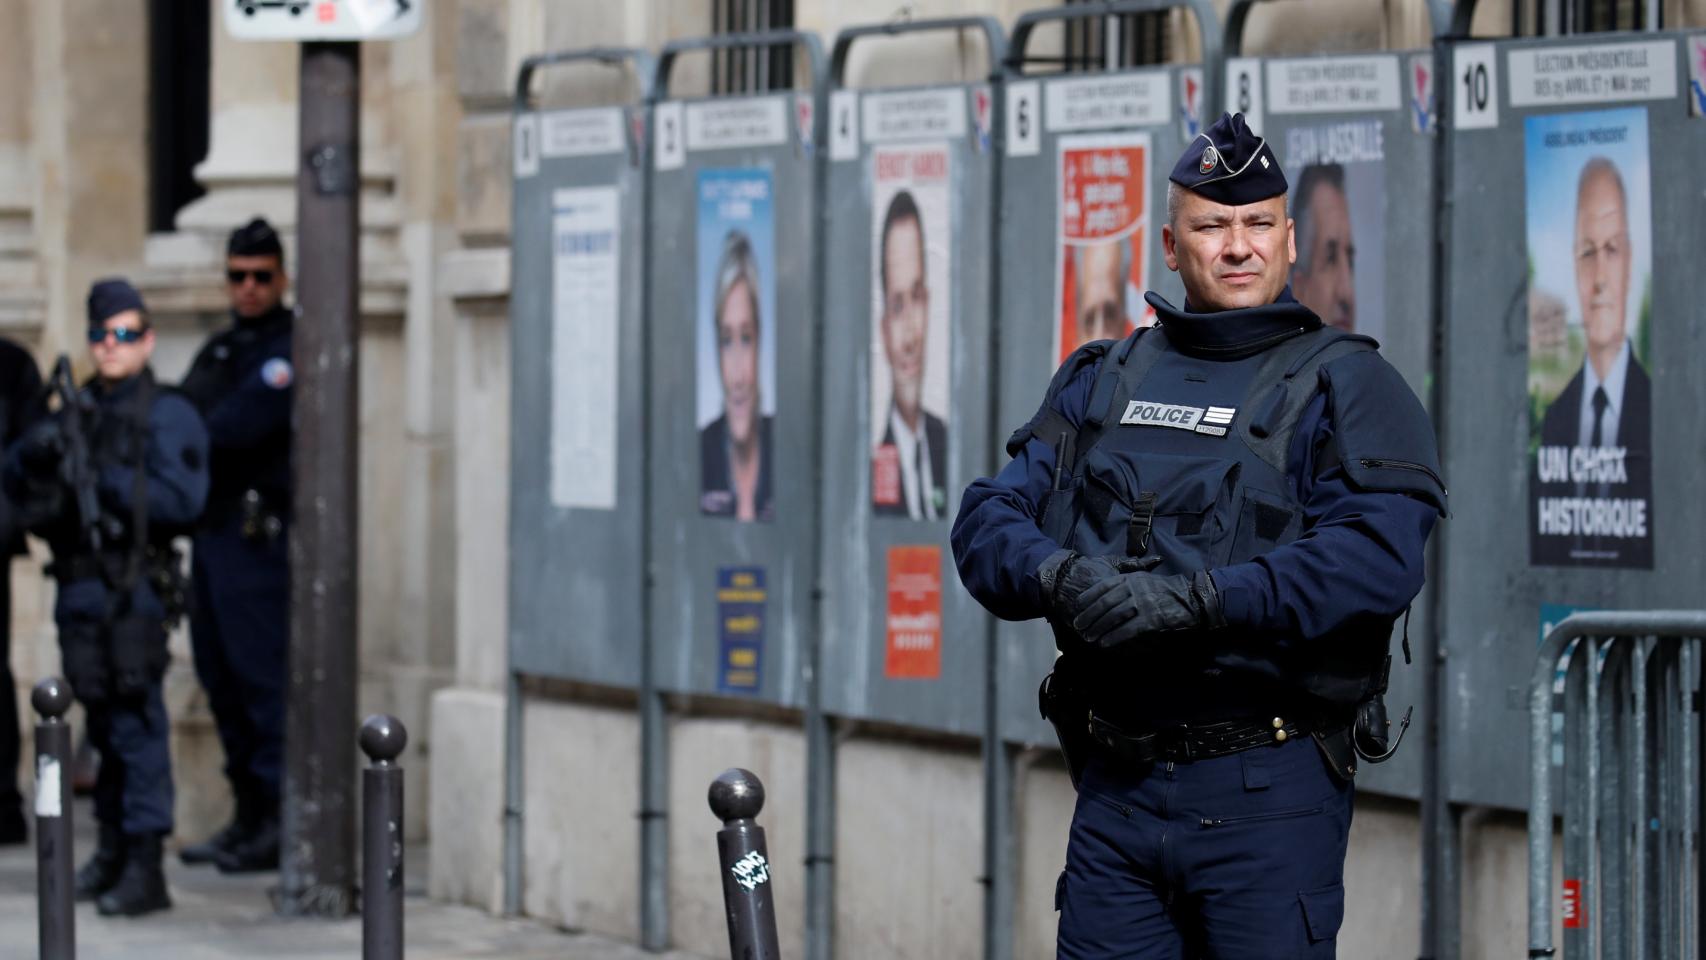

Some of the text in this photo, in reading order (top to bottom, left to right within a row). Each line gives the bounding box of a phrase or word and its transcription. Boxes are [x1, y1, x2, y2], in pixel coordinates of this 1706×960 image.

[1238, 71, 1252, 114] 8
[1463, 63, 1489, 113] 10
[1018, 96, 1031, 141] 6
[1129, 404, 1195, 425] POLICE
[1537, 445, 1628, 483] UN CHOIX
[1537, 497, 1647, 538] HISTORIQUE
